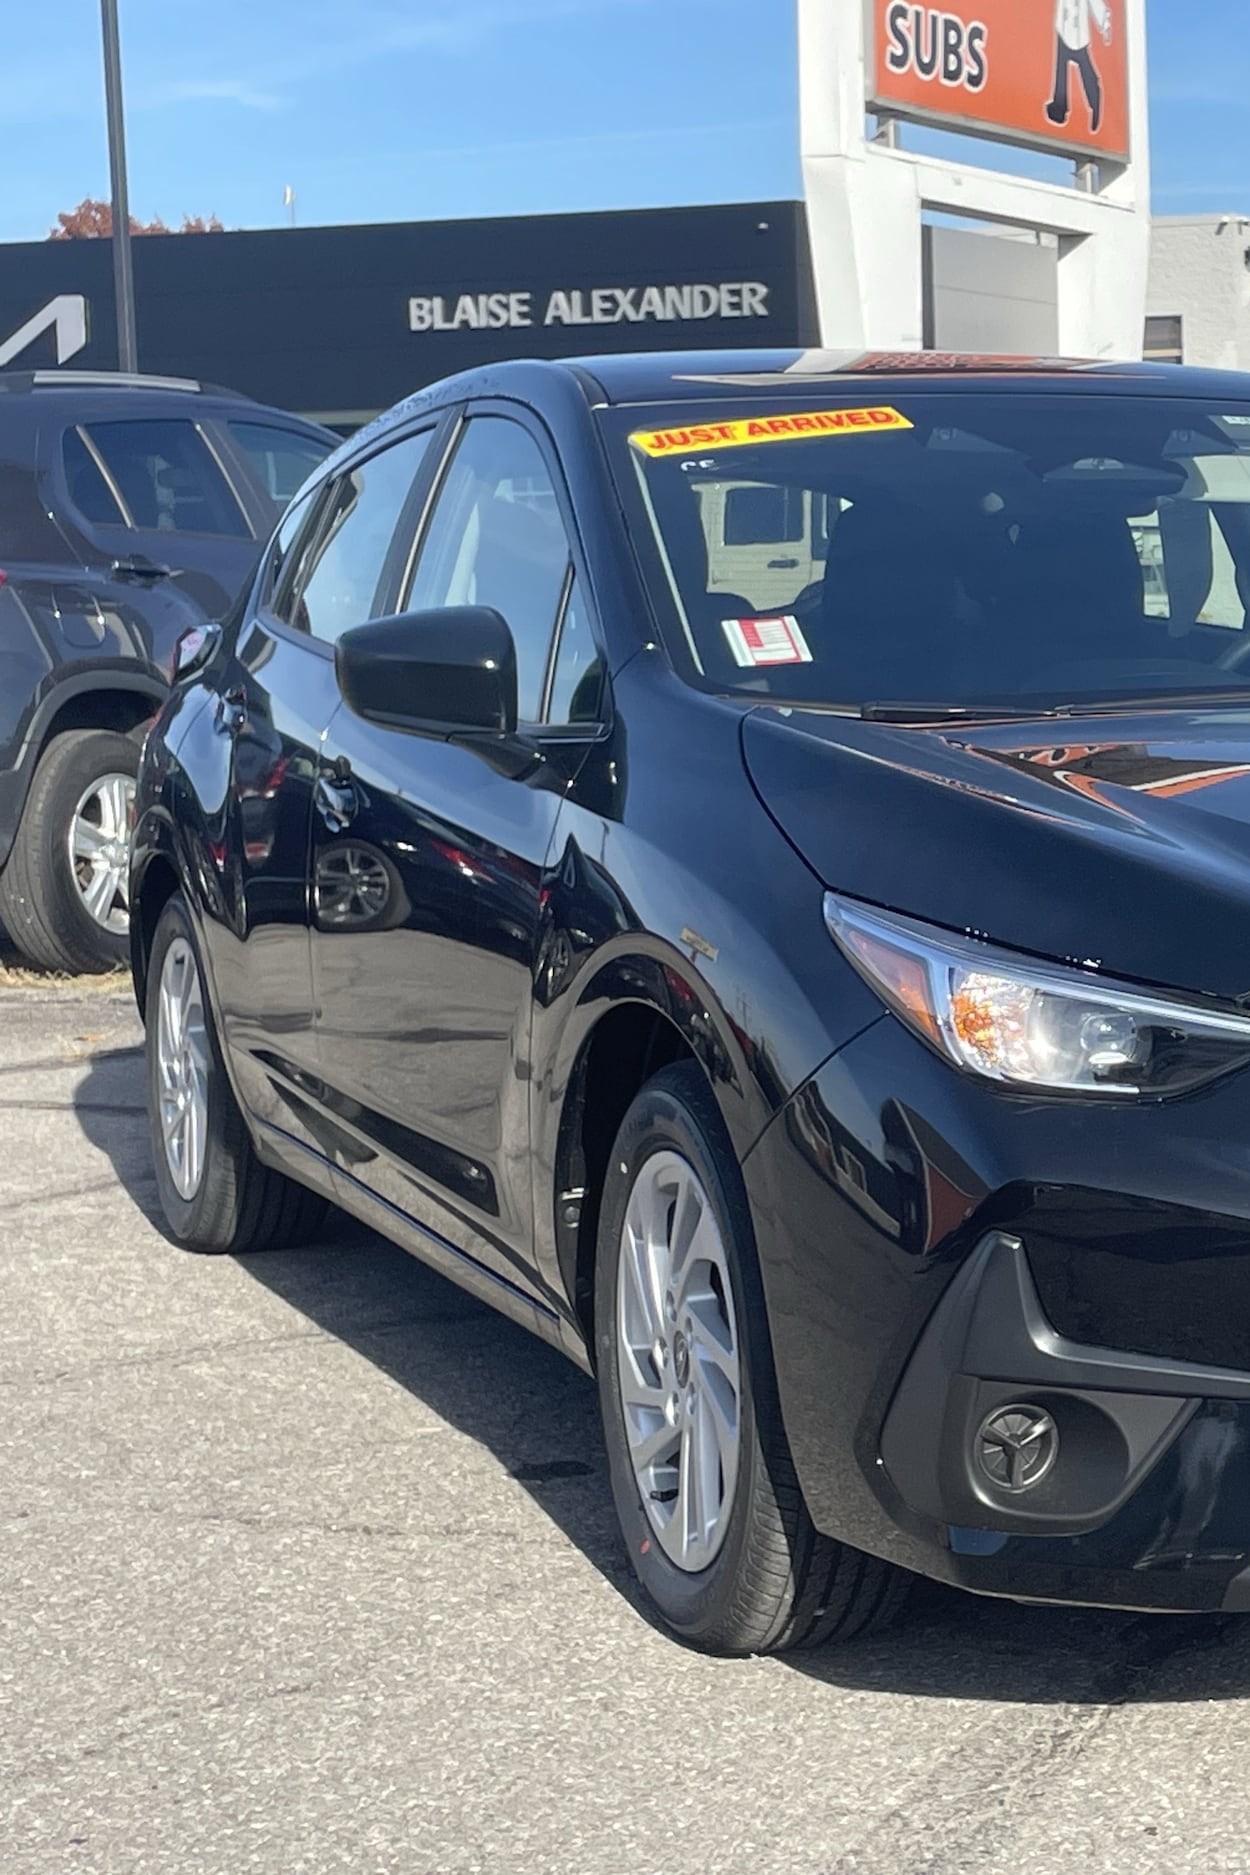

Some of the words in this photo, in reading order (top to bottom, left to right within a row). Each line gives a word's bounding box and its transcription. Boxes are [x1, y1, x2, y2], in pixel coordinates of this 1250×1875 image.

[887, 3, 987, 91] SUBS
[408, 292, 532, 331] BLAISE
[543, 281, 769, 326] ALEXANDER
[648, 424, 734, 449] JUST
[747, 409, 899, 436] ARRIVED
